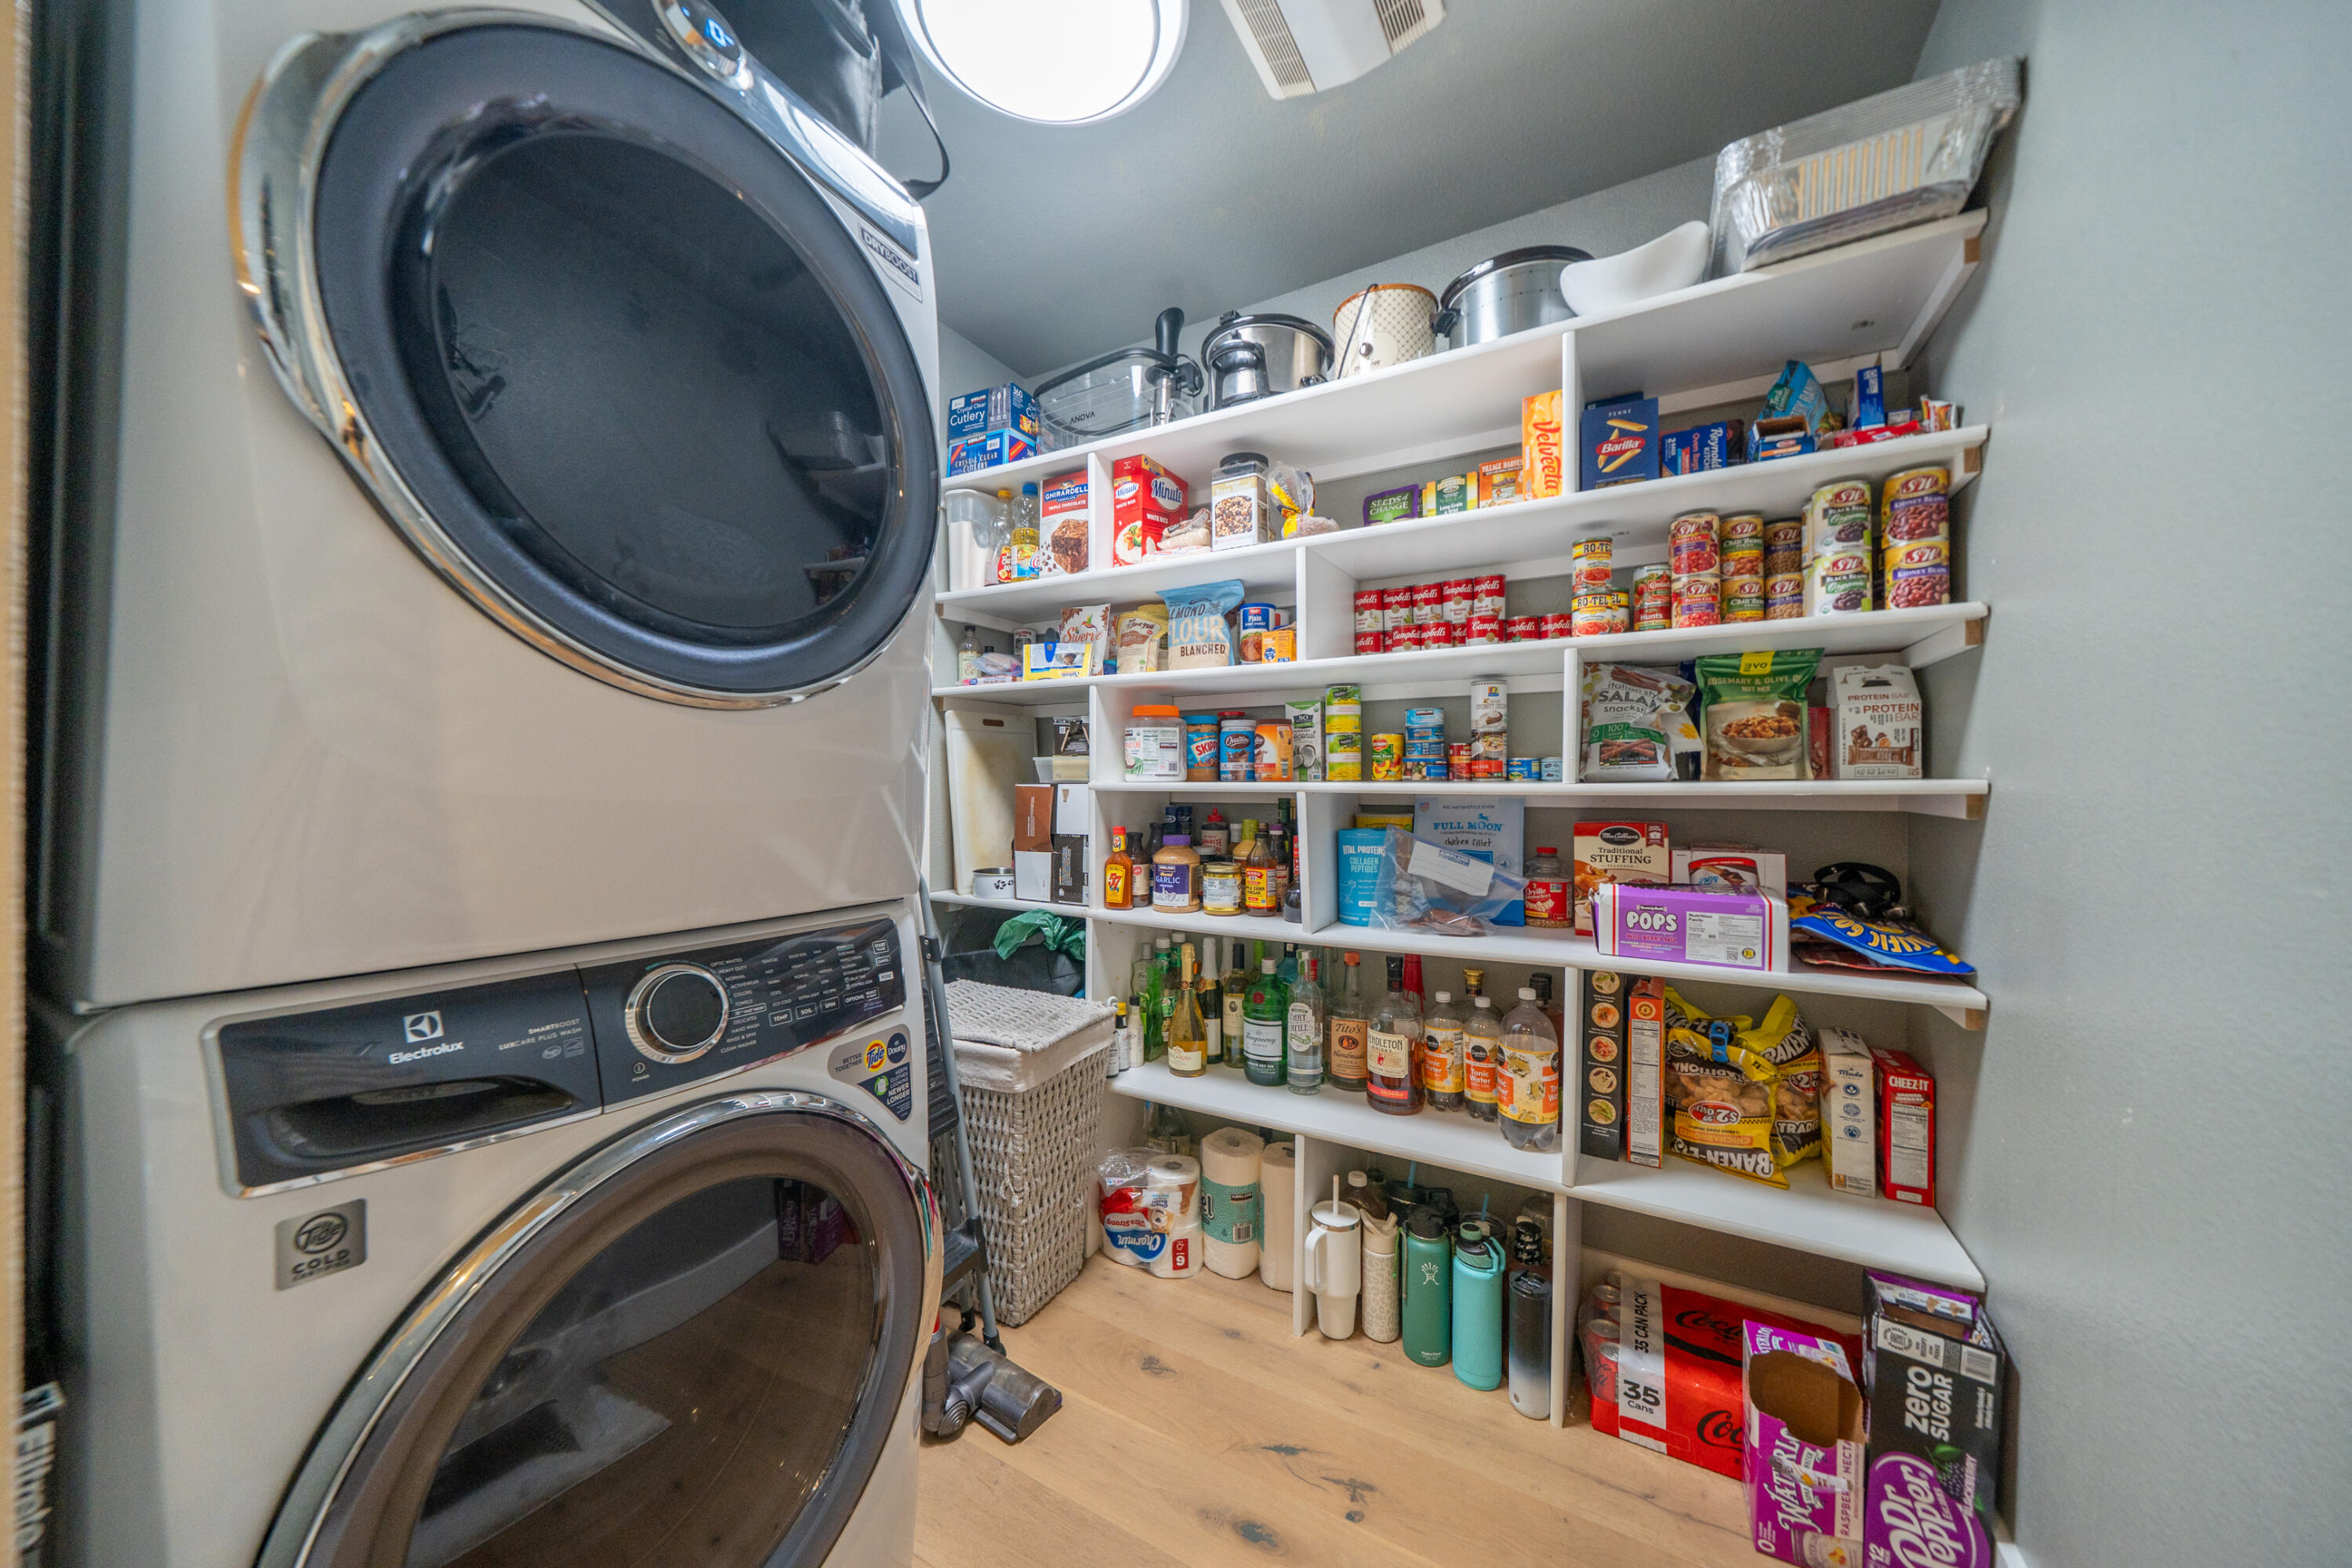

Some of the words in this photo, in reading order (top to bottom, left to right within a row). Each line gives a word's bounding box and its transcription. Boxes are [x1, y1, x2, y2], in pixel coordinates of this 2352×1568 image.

[864, 231, 916, 281] DRYBOOST
[1013, 386, 1023, 398] 360
[956, 404, 972, 414] Crystal
[1609, 408, 1632, 417] PENNE
[950, 410, 985, 426] Cutlery
[1069, 411, 1095, 424] ANOVA
[1601, 438, 1640, 454] Barilla
[1692, 433, 1700, 452] Oven
[1708, 427, 1724, 469] Reynold
[955, 456, 978, 468] CRYSTAL
[980, 452, 998, 462] CLEAR
[1532, 420, 1563, 492] Velveeta
[1482, 463, 1502, 473] VILLAGE
[1503, 459, 1523, 470] HARVES
[1045, 486, 1088, 500] GHIRARDELL
[1117, 483, 1138, 498] Minute
[1152, 479, 1182, 503] Minute
[1062, 499, 1087, 508] CHOCOLATE
[1370, 495, 1401, 508] SEEDS
[1401, 493, 1409, 503] of
[1894, 498, 1922, 508] KIDNEY
[1370, 501, 1409, 516] CHANGE
[1146, 513, 1159, 522] WHITE
[1160, 516, 1169, 524] RICE
[1897, 568, 1927, 578] KIDNEY
[1063, 626, 1104, 644] Swerve
[1180, 643, 1226, 657] BLANCHED
[1708, 677, 1750, 687] ROSEMARY
[1765, 675, 1789, 684] OLIVE
[1847, 693, 1889, 702] PROTEIN
[1891, 691, 1911, 700] BAR
[1863, 702, 1919, 713] PROTEIN
[1895, 712, 1919, 722] BAR
[1225, 736, 1250, 747] Ovaltine
[1433, 822, 1464, 830] FULL
[1467, 822, 1503, 832] MOON
[1444, 837, 1470, 847] chicken
[1472, 838, 1493, 848] fillet
[1343, 845, 1356, 855] VITAL
[1357, 845, 1387, 857] PROTEINS
[1441, 851, 1470, 862] KIRKLAND
[1598, 846, 1643, 855] Traditional
[1349, 857, 1379, 866] COLLAGEN
[1590, 854, 1652, 865] STUFFING
[1351, 865, 1378, 873] PEPTIDES
[1108, 873, 1123, 889] 57
[1155, 876, 1181, 884] GARLIC
[1625, 910, 1679, 932] POPS
[845, 993, 865, 1003] OPTIONS
[528, 1018, 580, 1035] SMARTBOOST
[1335, 1022, 1363, 1035] Tito's
[499, 1036, 536, 1051] LUXCARE
[538, 1032, 557, 1042] PLUS
[559, 1027, 583, 1036] WASH
[737, 1040, 757, 1048] WASHER
[1245, 1032, 1277, 1045] Tanqueray
[388, 1041, 464, 1065] Electrolux
[887, 1044, 906, 1056] Downy
[1333, 1050, 1366, 1060] Handmade
[842, 1052, 862, 1065] BETTER
[866, 1046, 885, 1069] Tide
[1425, 1058, 1440, 1067] Tonic
[835, 1058, 862, 1073] TOGETHER
[890, 1072, 909, 1083] CLOTHES
[1469, 1074, 1490, 1084] Water
[1470, 1068, 1490, 1077] Tonic
[1837, 1069, 1864, 1078] Made
[890, 1077, 909, 1088] LOOKING
[888, 1082, 909, 1097] NEWER
[887, 1089, 910, 1105] LONGER
[1106, 1218, 1130, 1228] Strong
[1131, 1219, 1145, 1228] Ultra
[1117, 1234, 1160, 1251] Charmin
[292, 1248, 349, 1275] COLD
[1634, 1290, 1648, 1317] PACK
[1635, 1318, 1649, 1338] CAN
[1635, 1339, 1649, 1354] 35
[1623, 1379, 1661, 1407] 35
[1627, 1399, 1655, 1415] Cans
[1904, 1366, 1933, 1435] zero
[1930, 1373, 1953, 1443] SUGAR
[1963, 1453, 1978, 1518] BLACKBERRY
[1879, 1465, 1922, 1534] Dr
[1889, 1465, 1966, 1568] Pepper
[1870, 1543, 1886, 1562] 12
